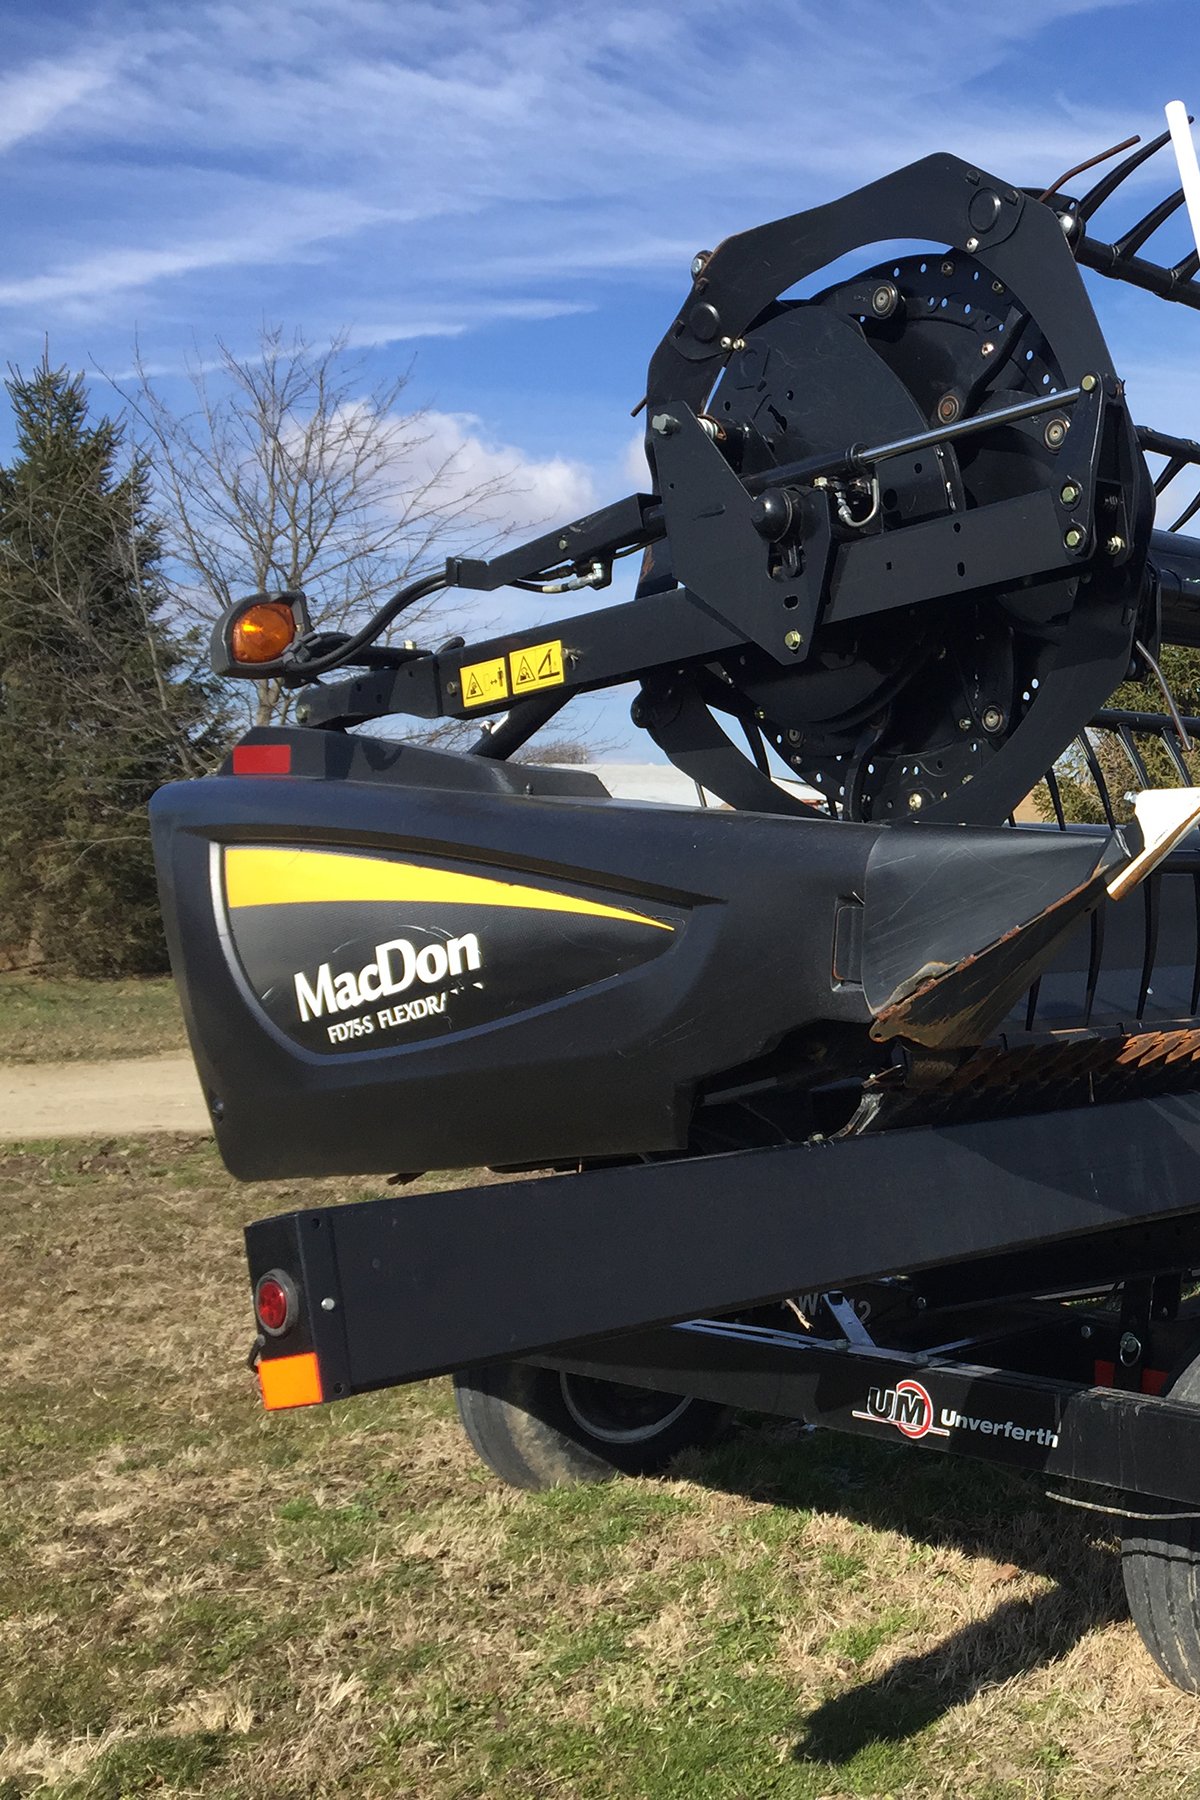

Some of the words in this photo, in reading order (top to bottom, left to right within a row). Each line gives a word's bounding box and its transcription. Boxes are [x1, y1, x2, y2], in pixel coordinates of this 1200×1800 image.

[293, 932, 482, 1023] MacDon
[866, 1386, 926, 1429] UM
[940, 1408, 1059, 1449] Unverferth
